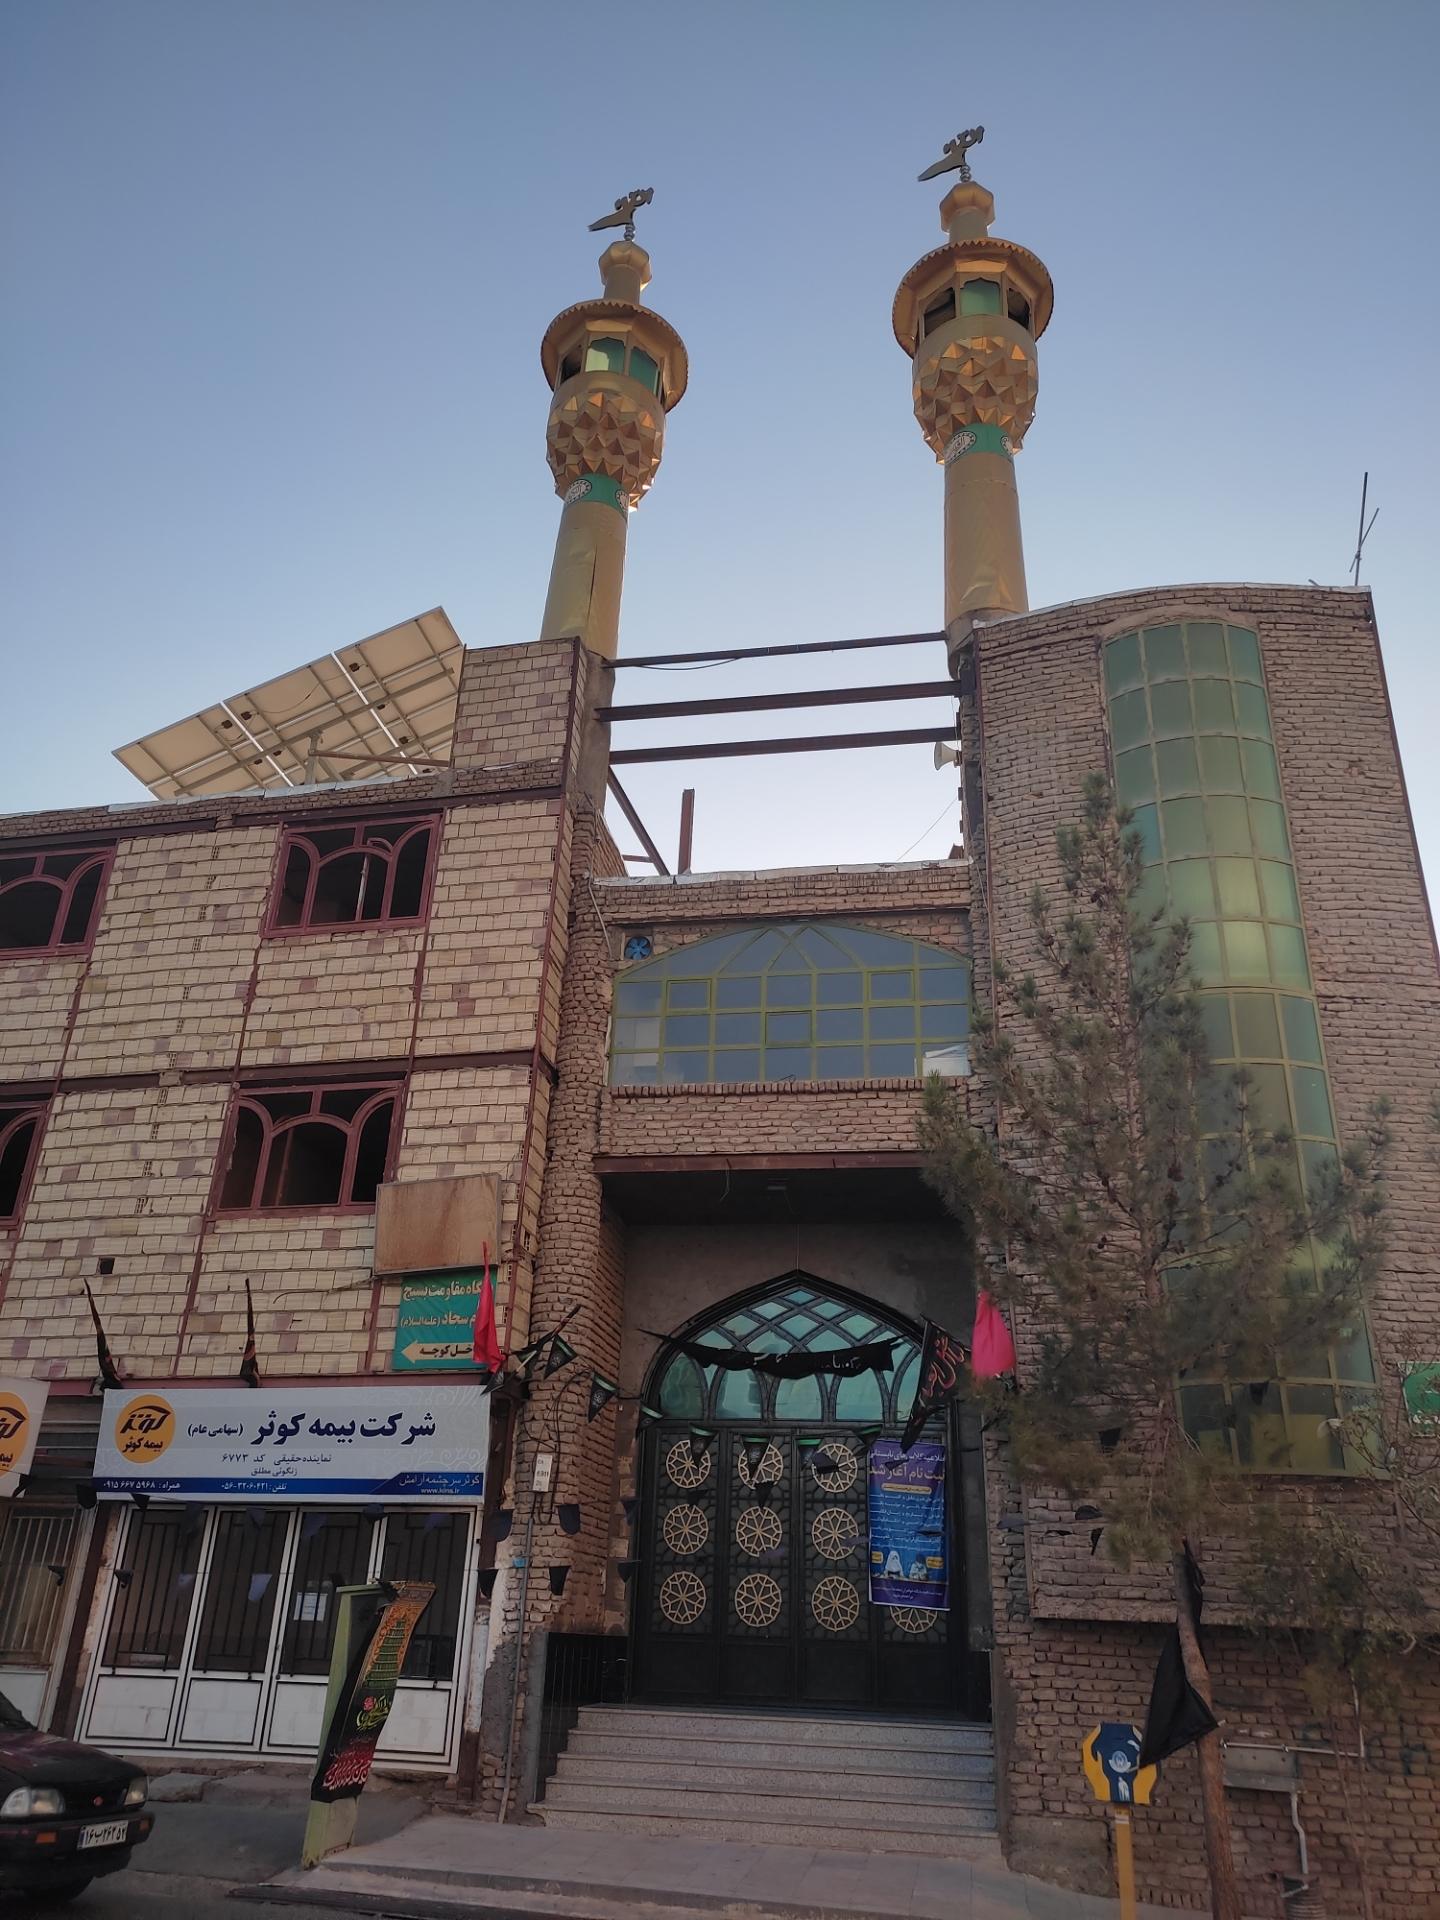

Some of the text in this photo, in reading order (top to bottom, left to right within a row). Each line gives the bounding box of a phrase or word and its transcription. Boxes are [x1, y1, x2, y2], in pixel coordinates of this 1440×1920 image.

[403, 1286, 428, 1302] بسیج
[428, 1280, 465, 1300] مقاومت
[441, 1311, 469, 1328] سجاد
[419, 1345, 450, 1358] کوچه
[188, 1410, 436, 1445] شرکت بیمه کوثر (سهامی عام)
[122, 1436, 163, 1453] بیمه کوثر
[253, 1454, 266, 1462] کد
[274, 1454, 302, 1466] حقیقی
[302, 1453, 332, 1464] نماینده
[460, 1474, 480, 1487] کوثر
[909, 1466, 923, 1482] نام
